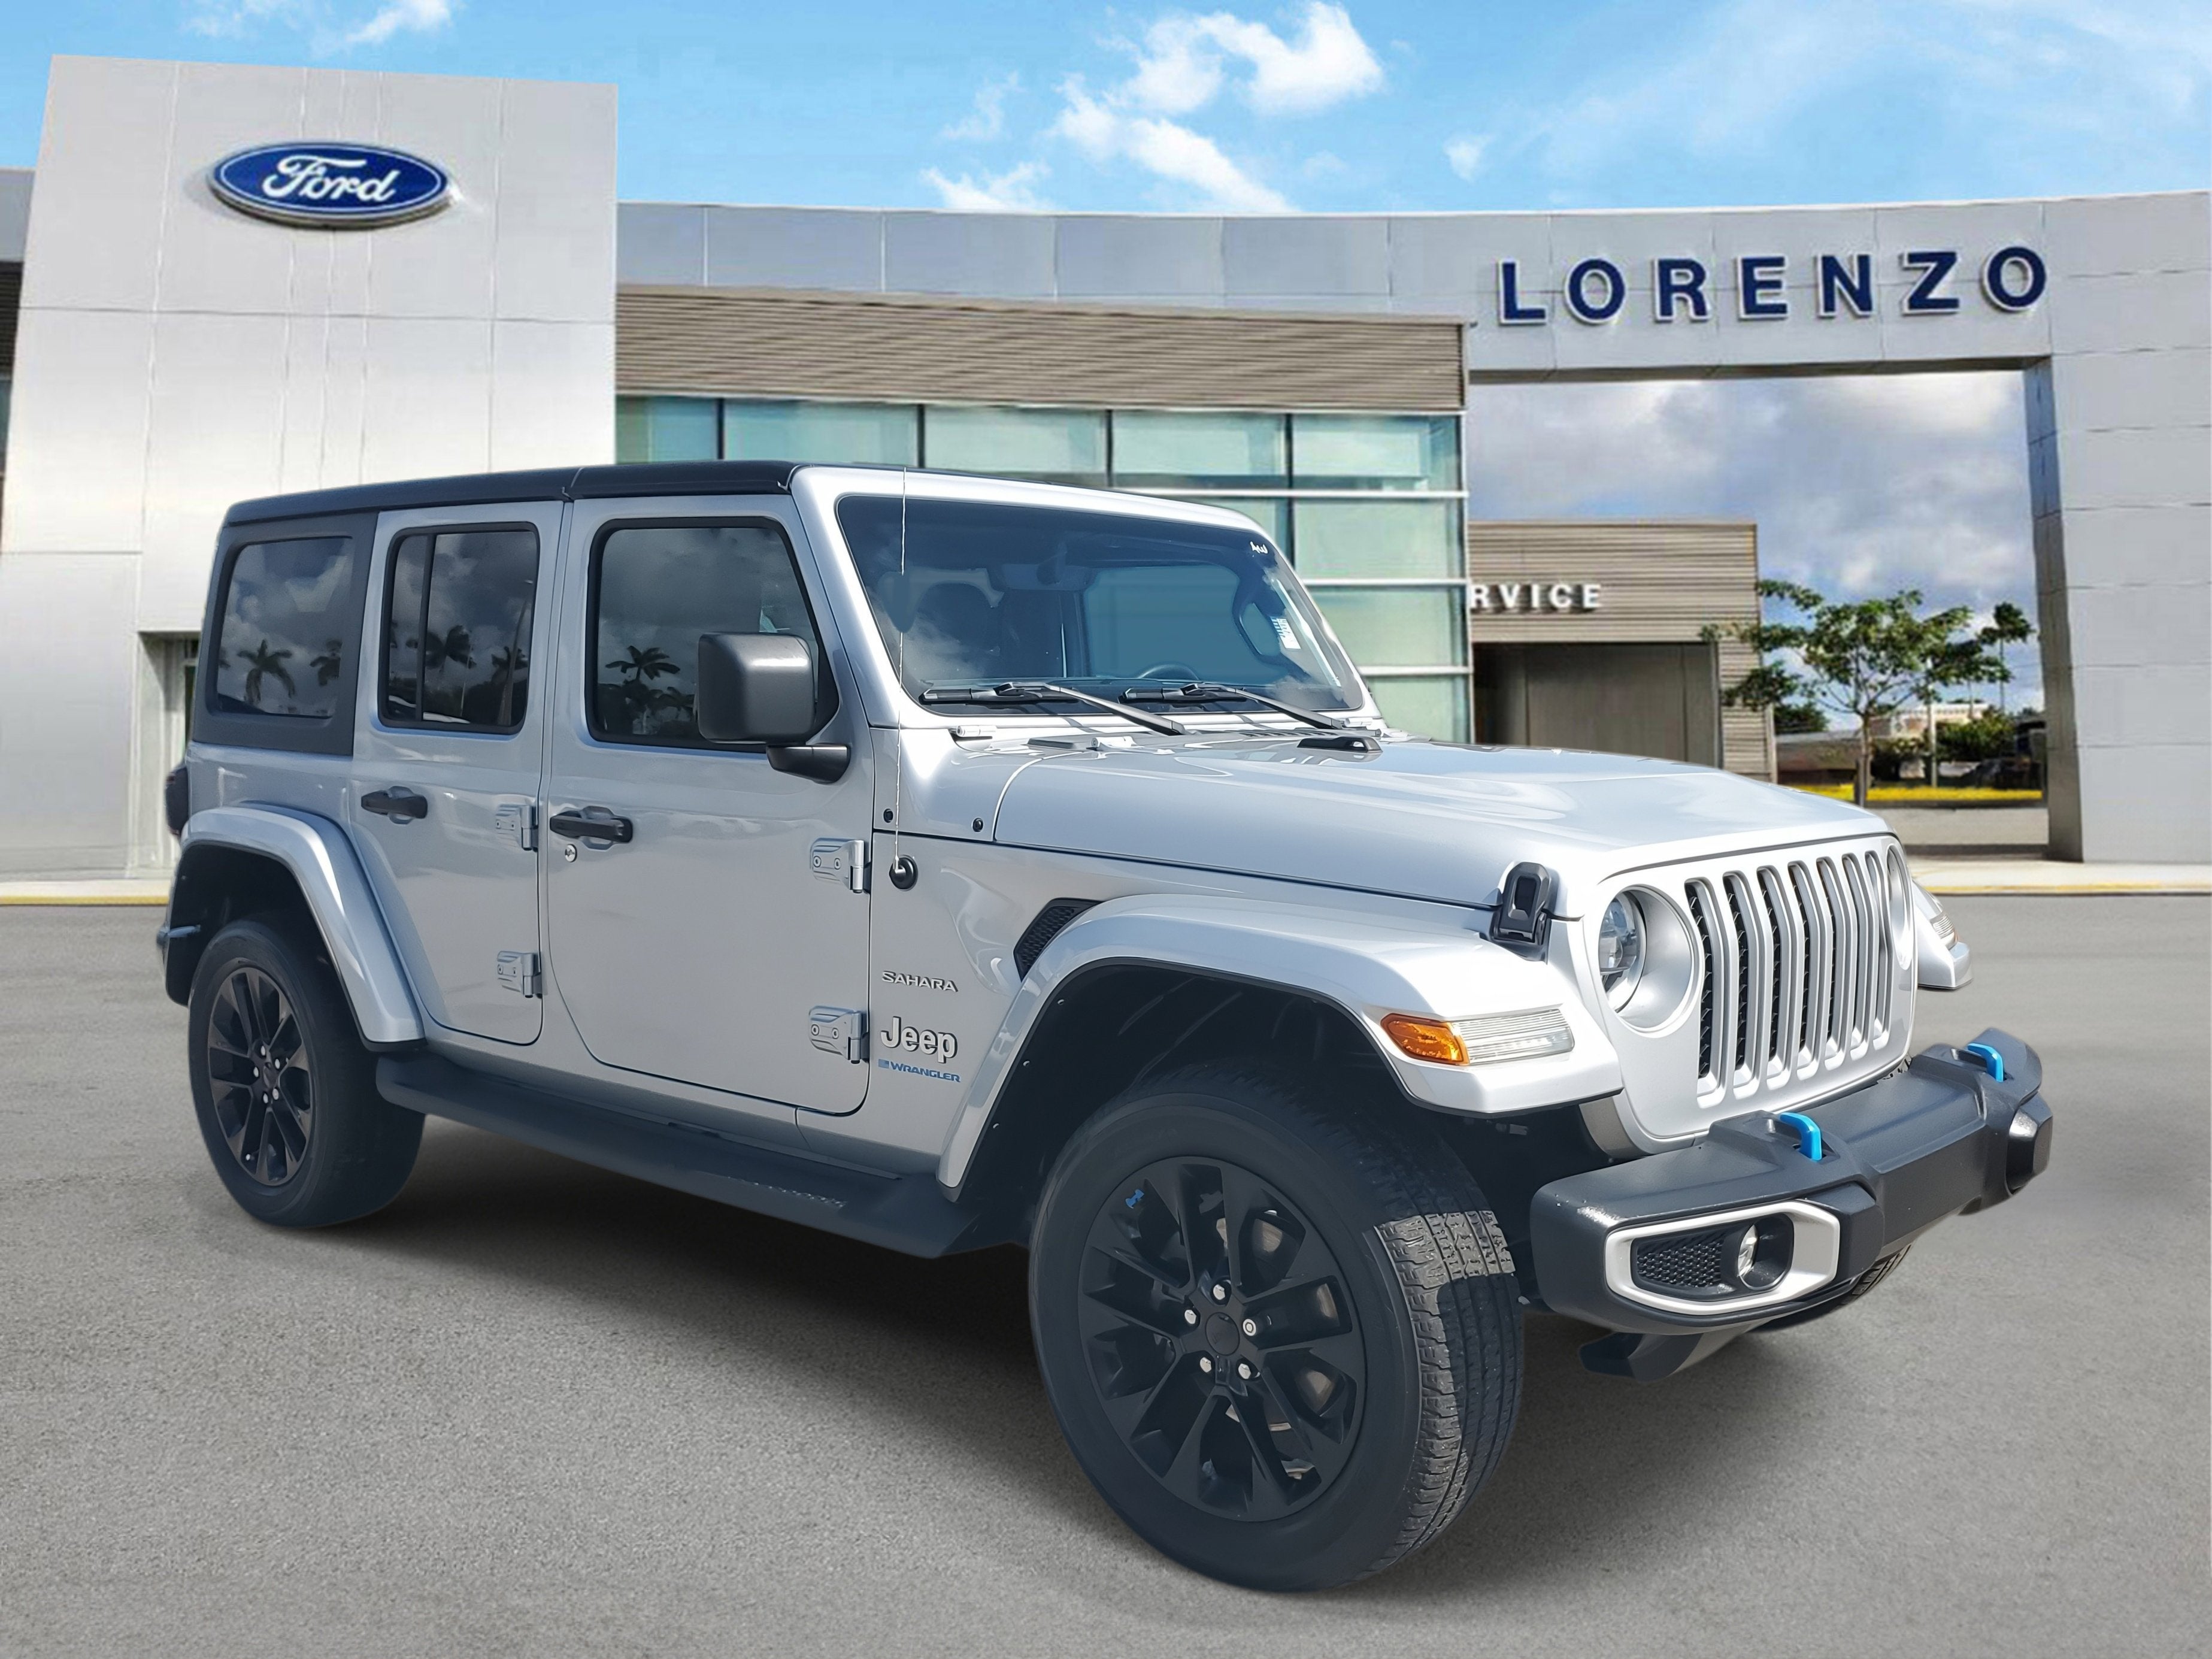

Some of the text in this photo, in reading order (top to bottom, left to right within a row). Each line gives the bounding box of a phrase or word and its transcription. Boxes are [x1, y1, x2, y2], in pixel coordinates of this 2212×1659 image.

[262, 154, 401, 202] Ford
[1498, 246, 2047, 326] LORENZO
[881, 970, 959, 992] SAHARA
[880, 1016, 958, 1064] Jeep
[890, 1061, 961, 1083] WRANGLER
